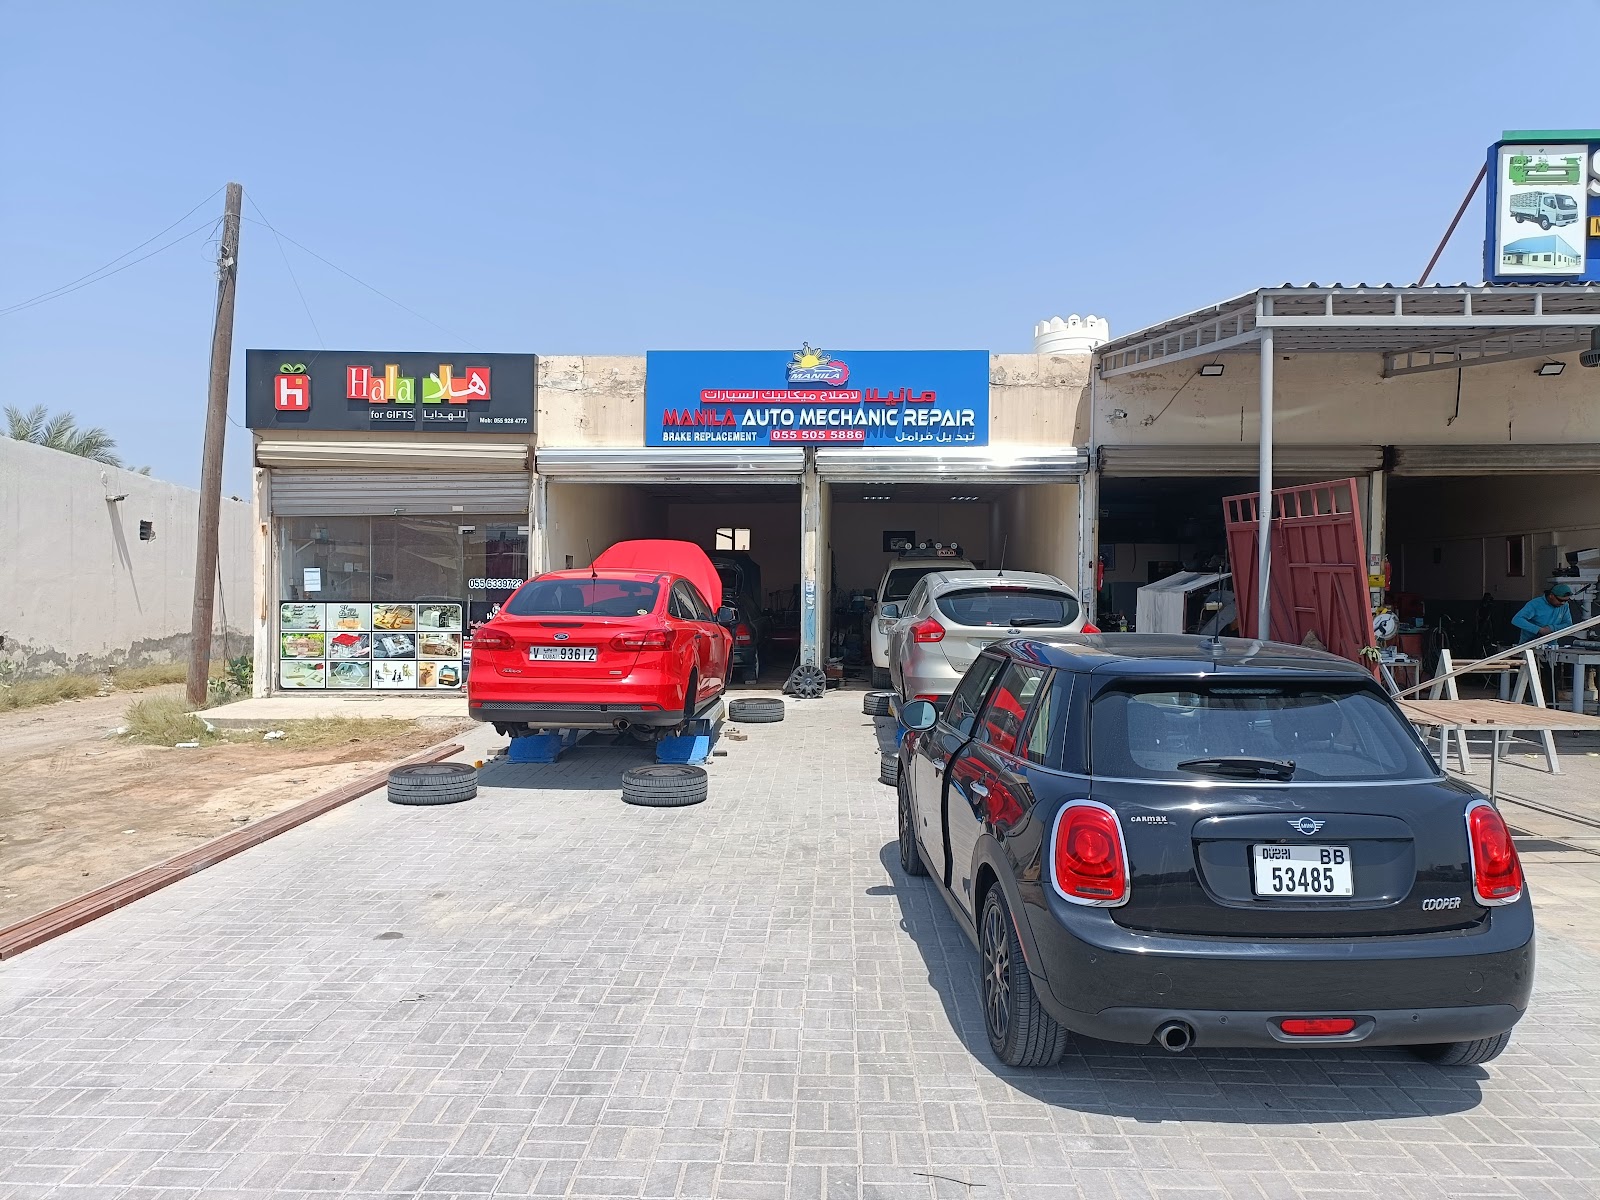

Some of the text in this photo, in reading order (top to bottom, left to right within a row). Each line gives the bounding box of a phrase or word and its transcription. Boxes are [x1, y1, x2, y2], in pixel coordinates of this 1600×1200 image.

[350, 366, 412, 401] Hala
[424, 365, 487, 399] هلا
[704, 389, 759, 402] السيارات
[762, 389, 817, 402] ميكانيك
[864, 388, 936, 406] مانيلا
[370, 410, 413, 419] for GIFTS
[423, 409, 466, 421] للهدايا
[662, 408, 975, 426] MANILA AUTO MECHANIC REPAIR
[663, 431, 757, 442] BRAKE REPLACEMENT
[773, 430, 863, 439] 055 505 5886
[895, 431, 933, 442] فرامل
[469, 579, 523, 589] 055 6339723
[533, 647, 540, 659] V
[560, 647, 595, 661] 93612
[1320, 848, 1345, 865] BB
[1272, 867, 1335, 893] 53485
[1422, 896, 1461, 911] COOPER
